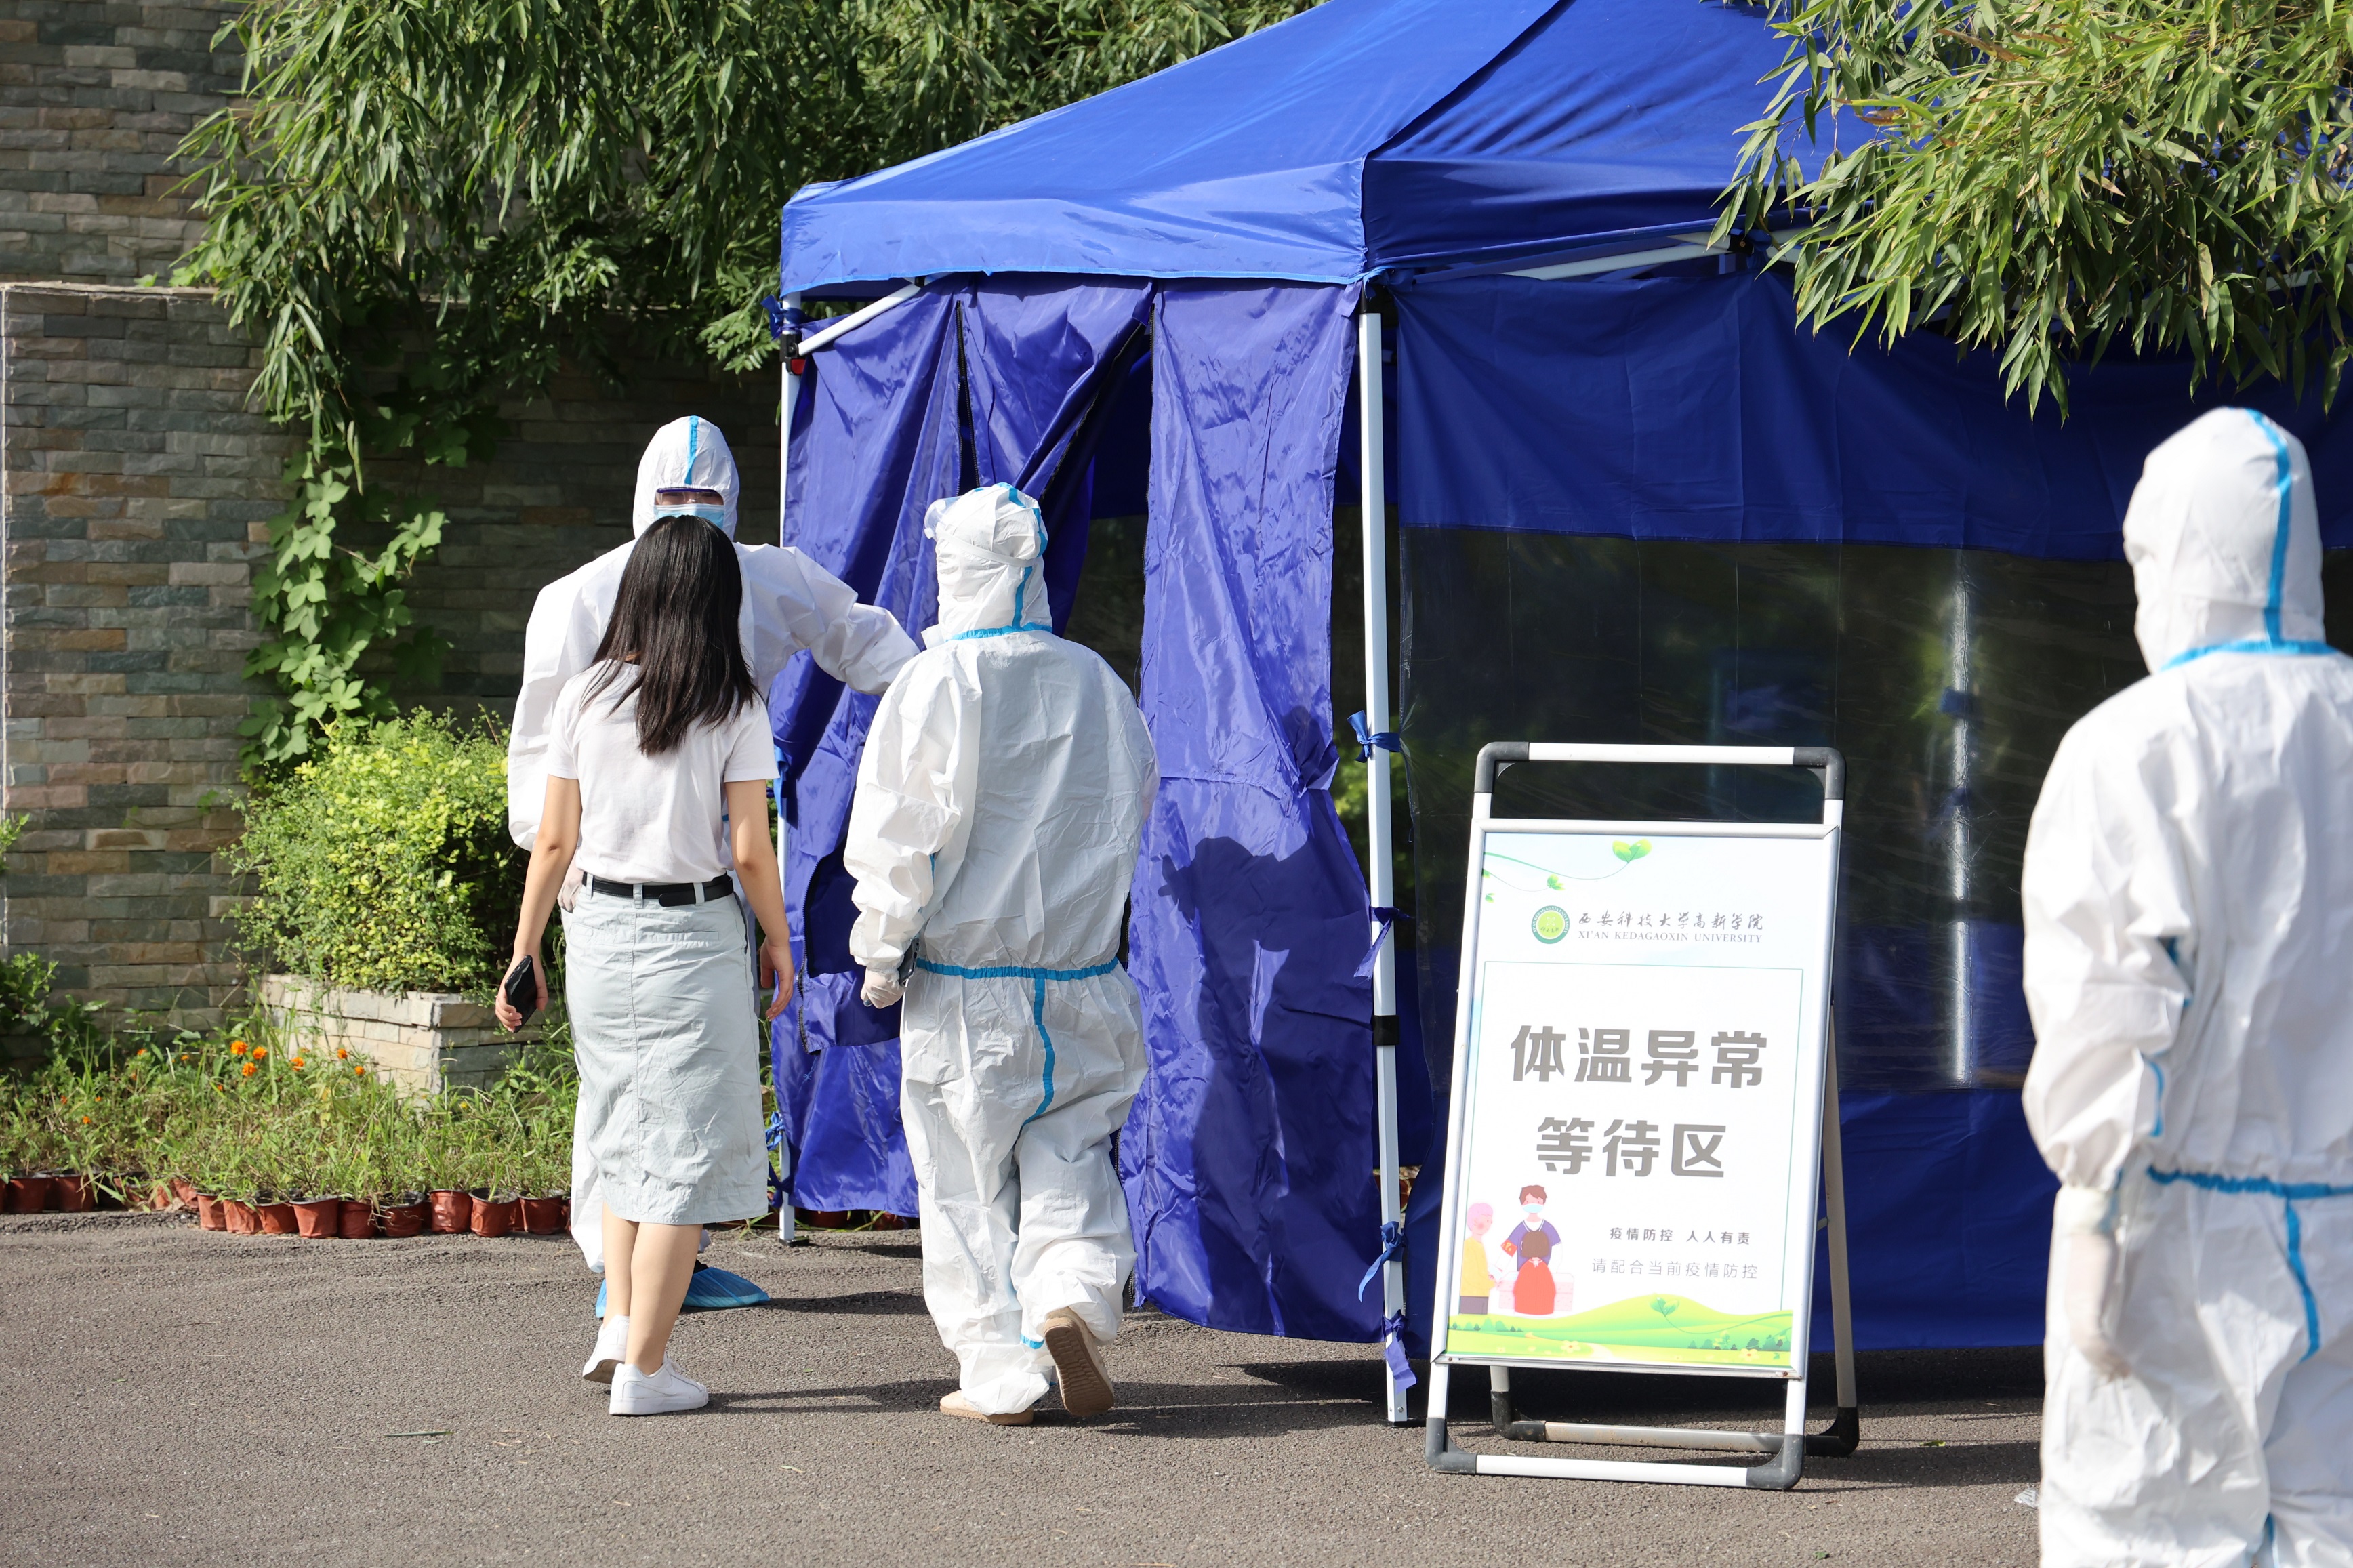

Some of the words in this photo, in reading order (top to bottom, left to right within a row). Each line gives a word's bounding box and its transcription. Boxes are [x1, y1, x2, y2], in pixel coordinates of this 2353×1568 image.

[1578, 910, 1763, 930] 西安科技大学高新学院
[1578, 930, 1609, 940] XI'AN
[1614, 932, 1689, 942] KEDAGAOXIN
[1694, 933, 1763, 943] UNIVERSITY
[1511, 1025, 1767, 1088] 体温异常
[1537, 1117, 1725, 1177] 等待区
[1610, 1227, 1673, 1241] 疫情防控
[1686, 1230, 1750, 1245] 人人有责
[1593, 1258, 1757, 1279] 请配合当前疫情防控
